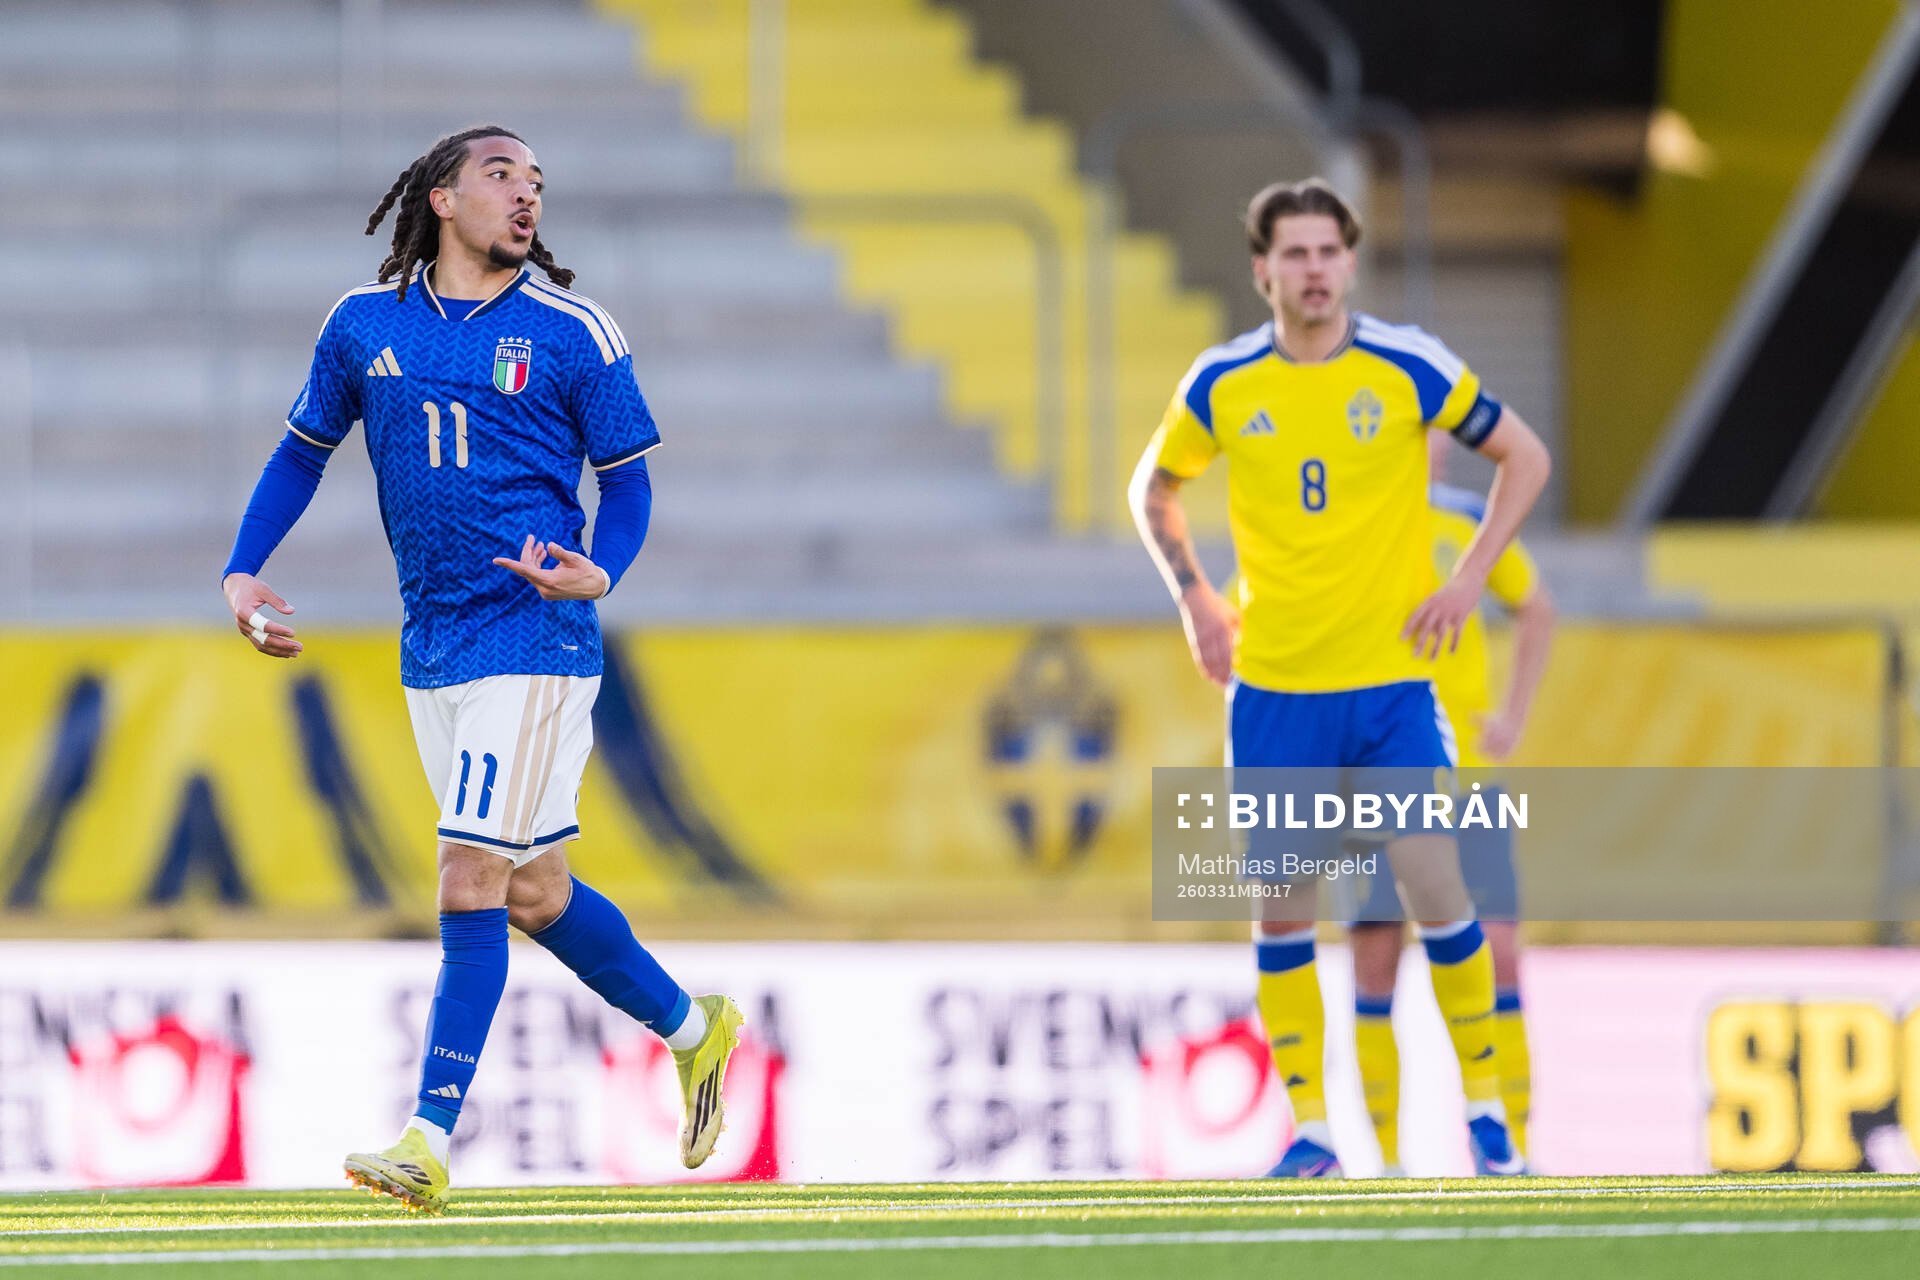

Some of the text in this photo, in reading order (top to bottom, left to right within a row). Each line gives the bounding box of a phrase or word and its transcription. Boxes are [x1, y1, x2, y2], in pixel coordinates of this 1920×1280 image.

[498, 348, 528, 359] ITALIA
[423, 401, 468, 468] 11
[1301, 459, 1327, 511] 8
[455, 750, 498, 819] 11
[434, 1045, 475, 1064] ITALIA
